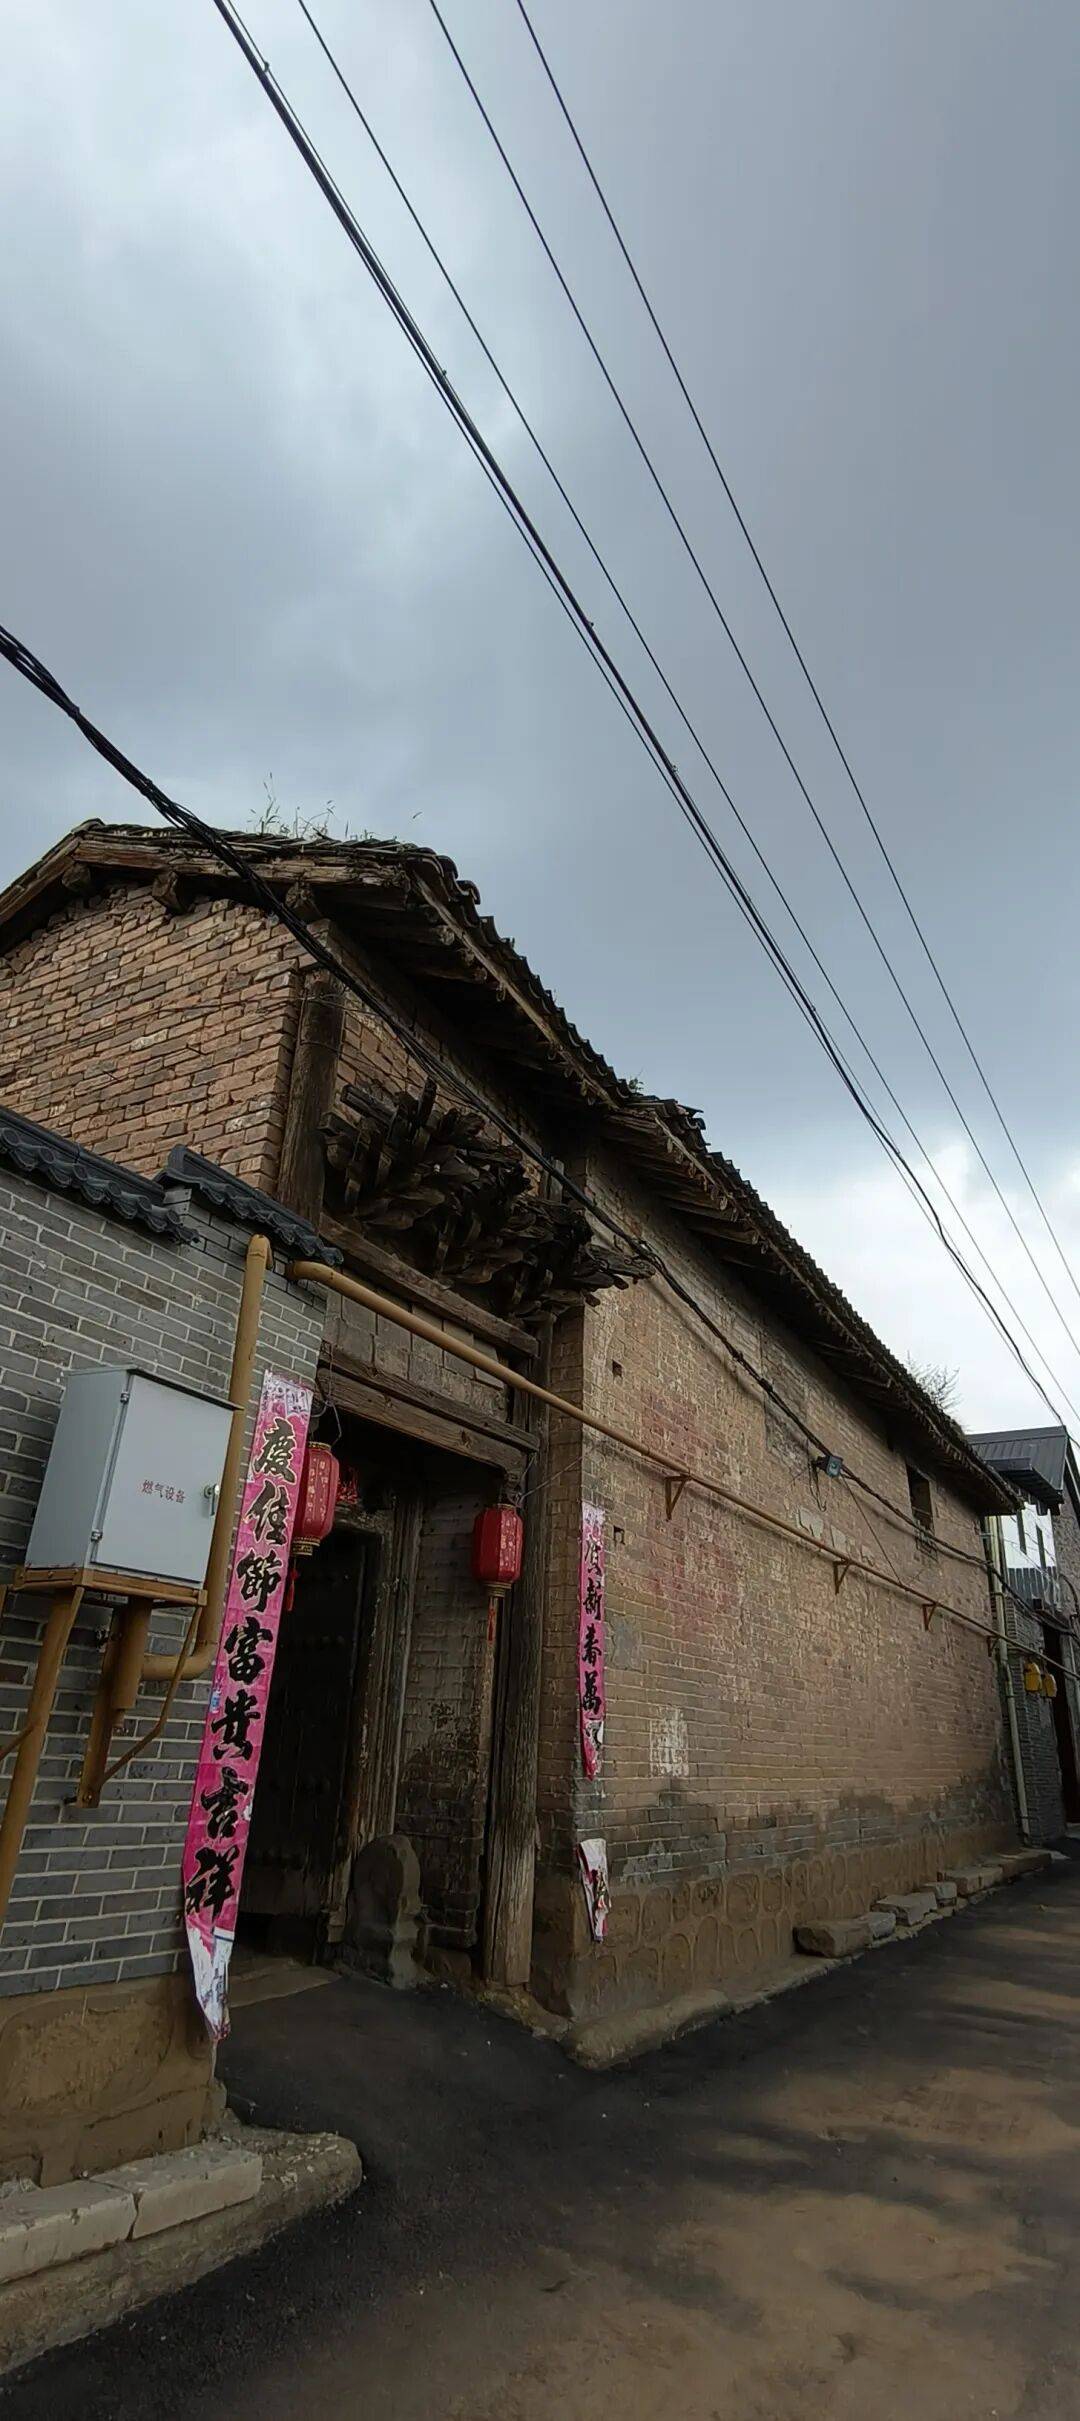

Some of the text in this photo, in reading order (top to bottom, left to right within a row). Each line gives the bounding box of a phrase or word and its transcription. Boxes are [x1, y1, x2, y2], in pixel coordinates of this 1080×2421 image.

[142, 1480, 186, 1503] 燃气设备
[581, 1534, 603, 1748] 賀新春萬
